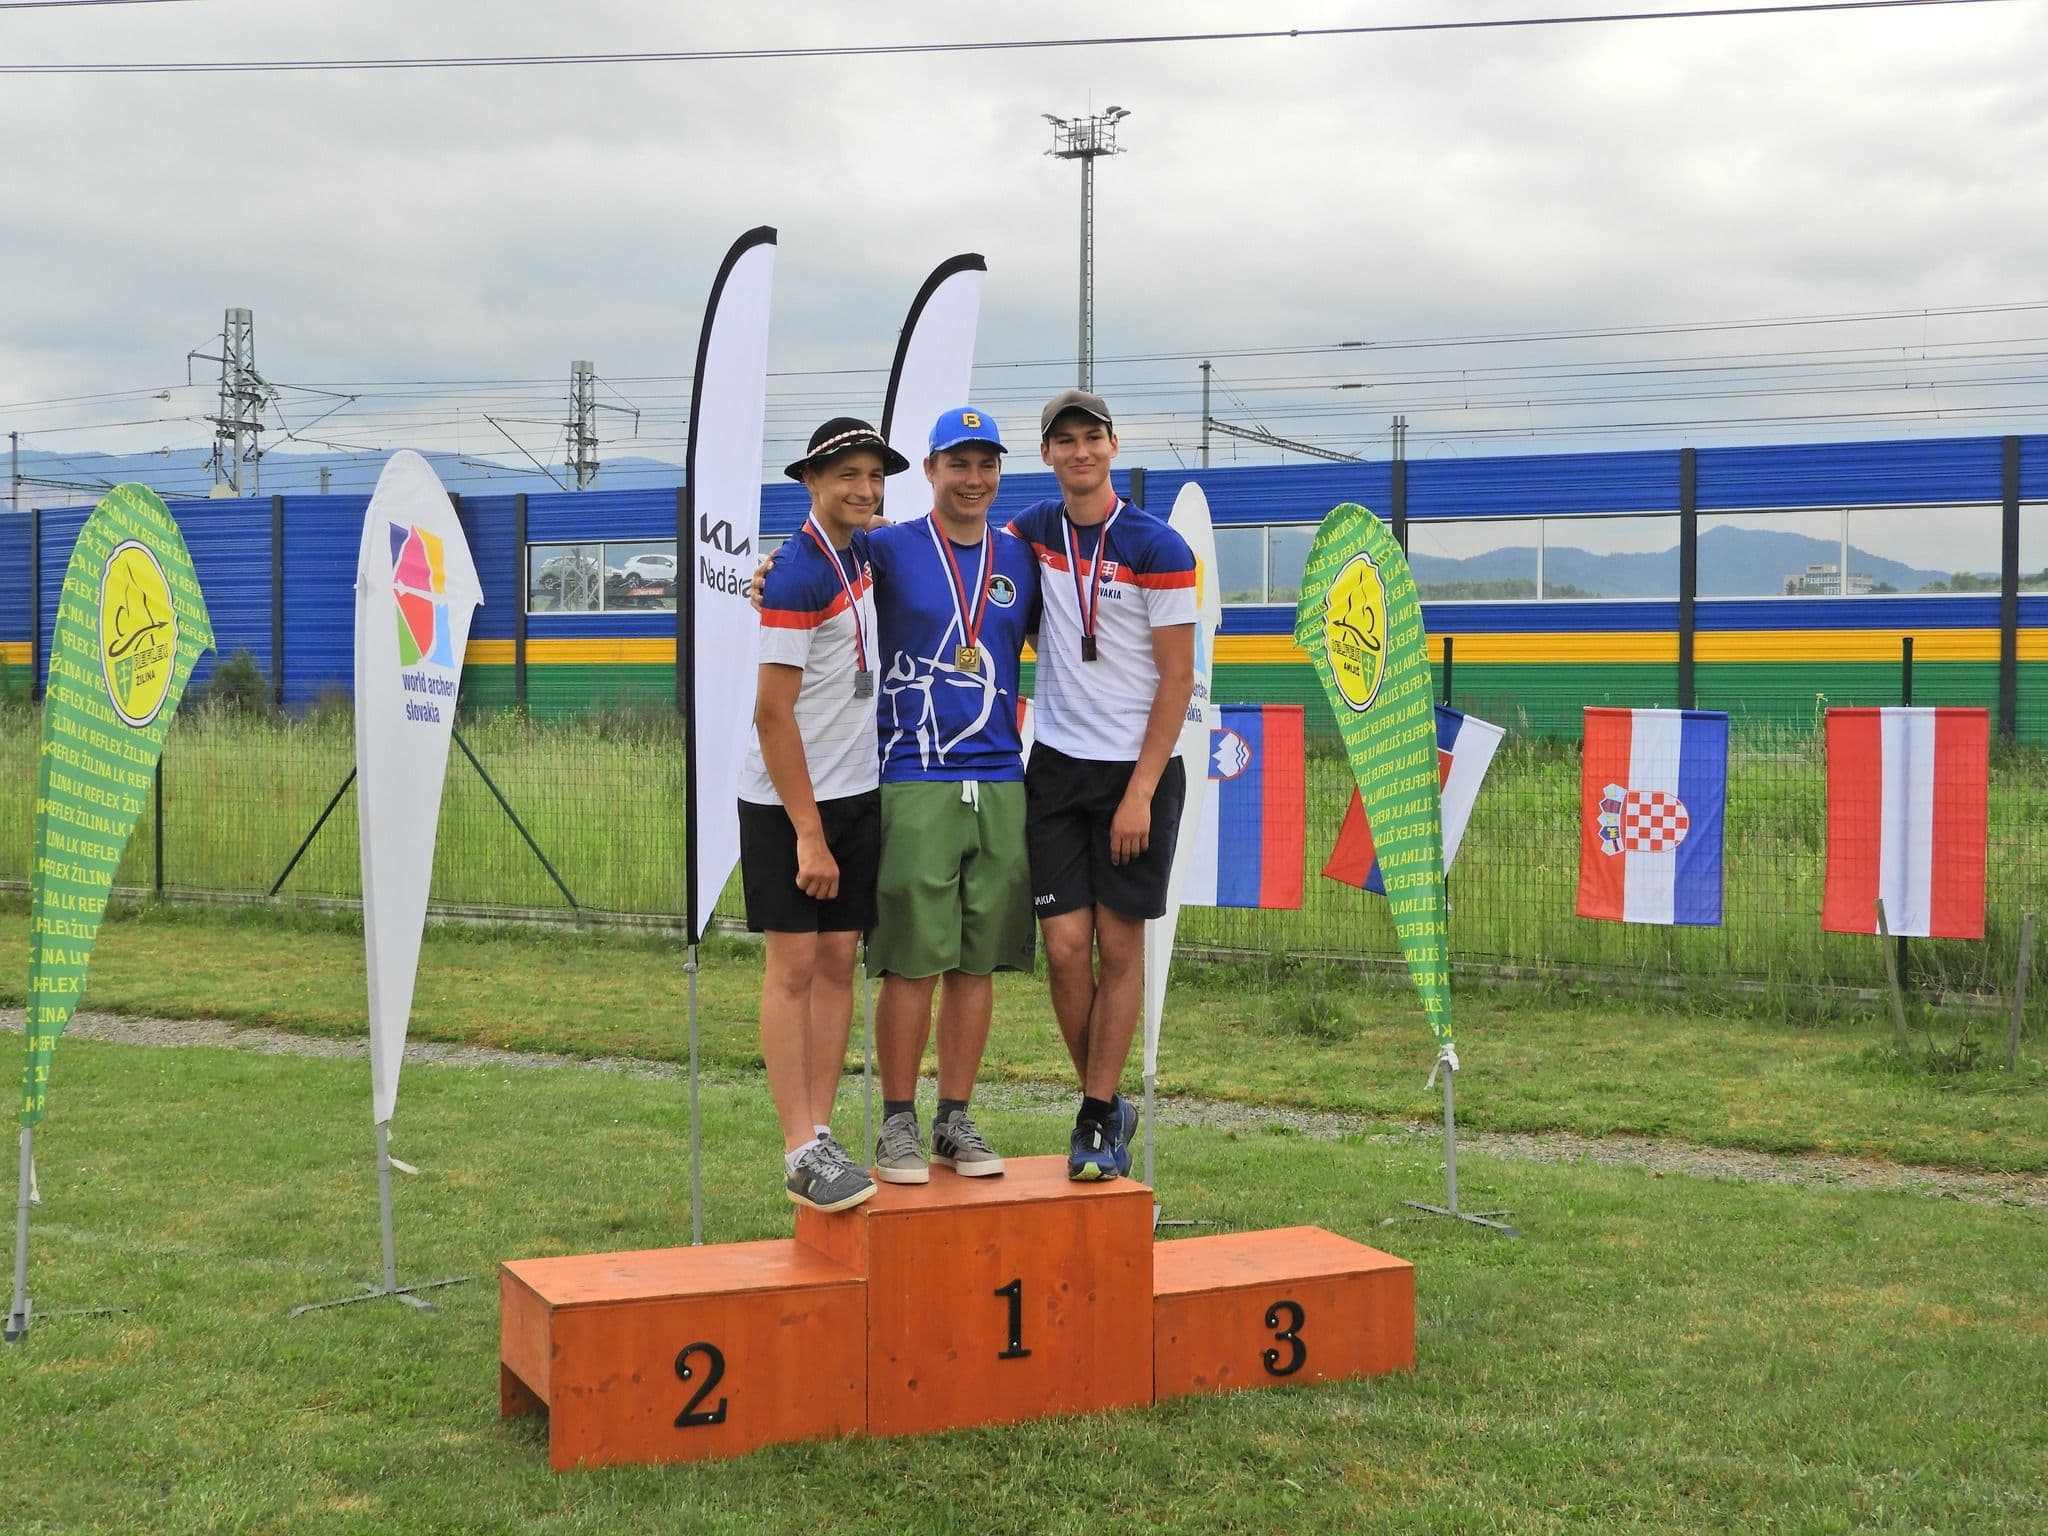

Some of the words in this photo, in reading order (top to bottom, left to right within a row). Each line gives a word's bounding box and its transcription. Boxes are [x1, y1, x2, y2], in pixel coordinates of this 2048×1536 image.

[962, 412, 982, 428] B
[136, 670, 155, 687] ŽILINA
[402, 671, 427, 693] world
[406, 699, 440, 723] slovakia
[89, 729, 123, 756] REFLEX
[81, 748, 112, 779] ŽILINA
[84, 786, 120, 810] REFLEX
[75, 804, 109, 834] ŽILINA
[80, 840, 120, 863] REFLEX
[71, 861, 113, 888] ŽILINA
[994, 1279, 1031, 1359] 1
[1264, 1301, 1307, 1377] 3
[674, 1342, 728, 1428] 2
